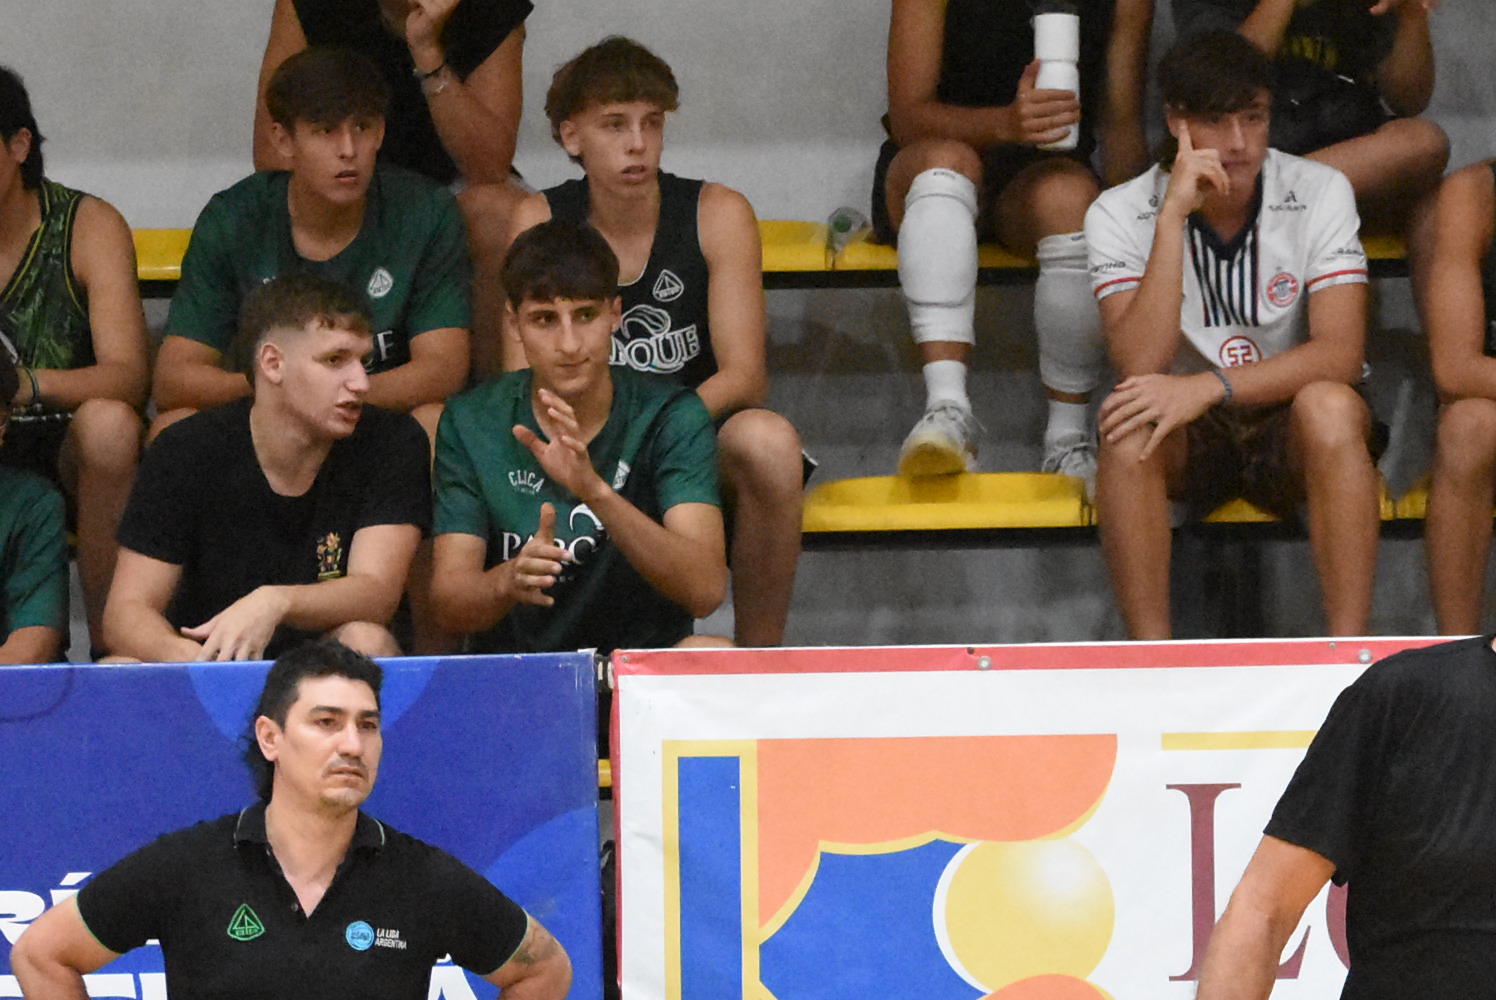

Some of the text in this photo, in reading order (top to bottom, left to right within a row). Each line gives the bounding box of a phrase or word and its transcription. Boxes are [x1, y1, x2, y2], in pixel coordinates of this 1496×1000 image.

[508, 469, 545, 493] CLICA
[376, 927, 385, 938] LA
[374, 937, 407, 950] ARGENTINA
